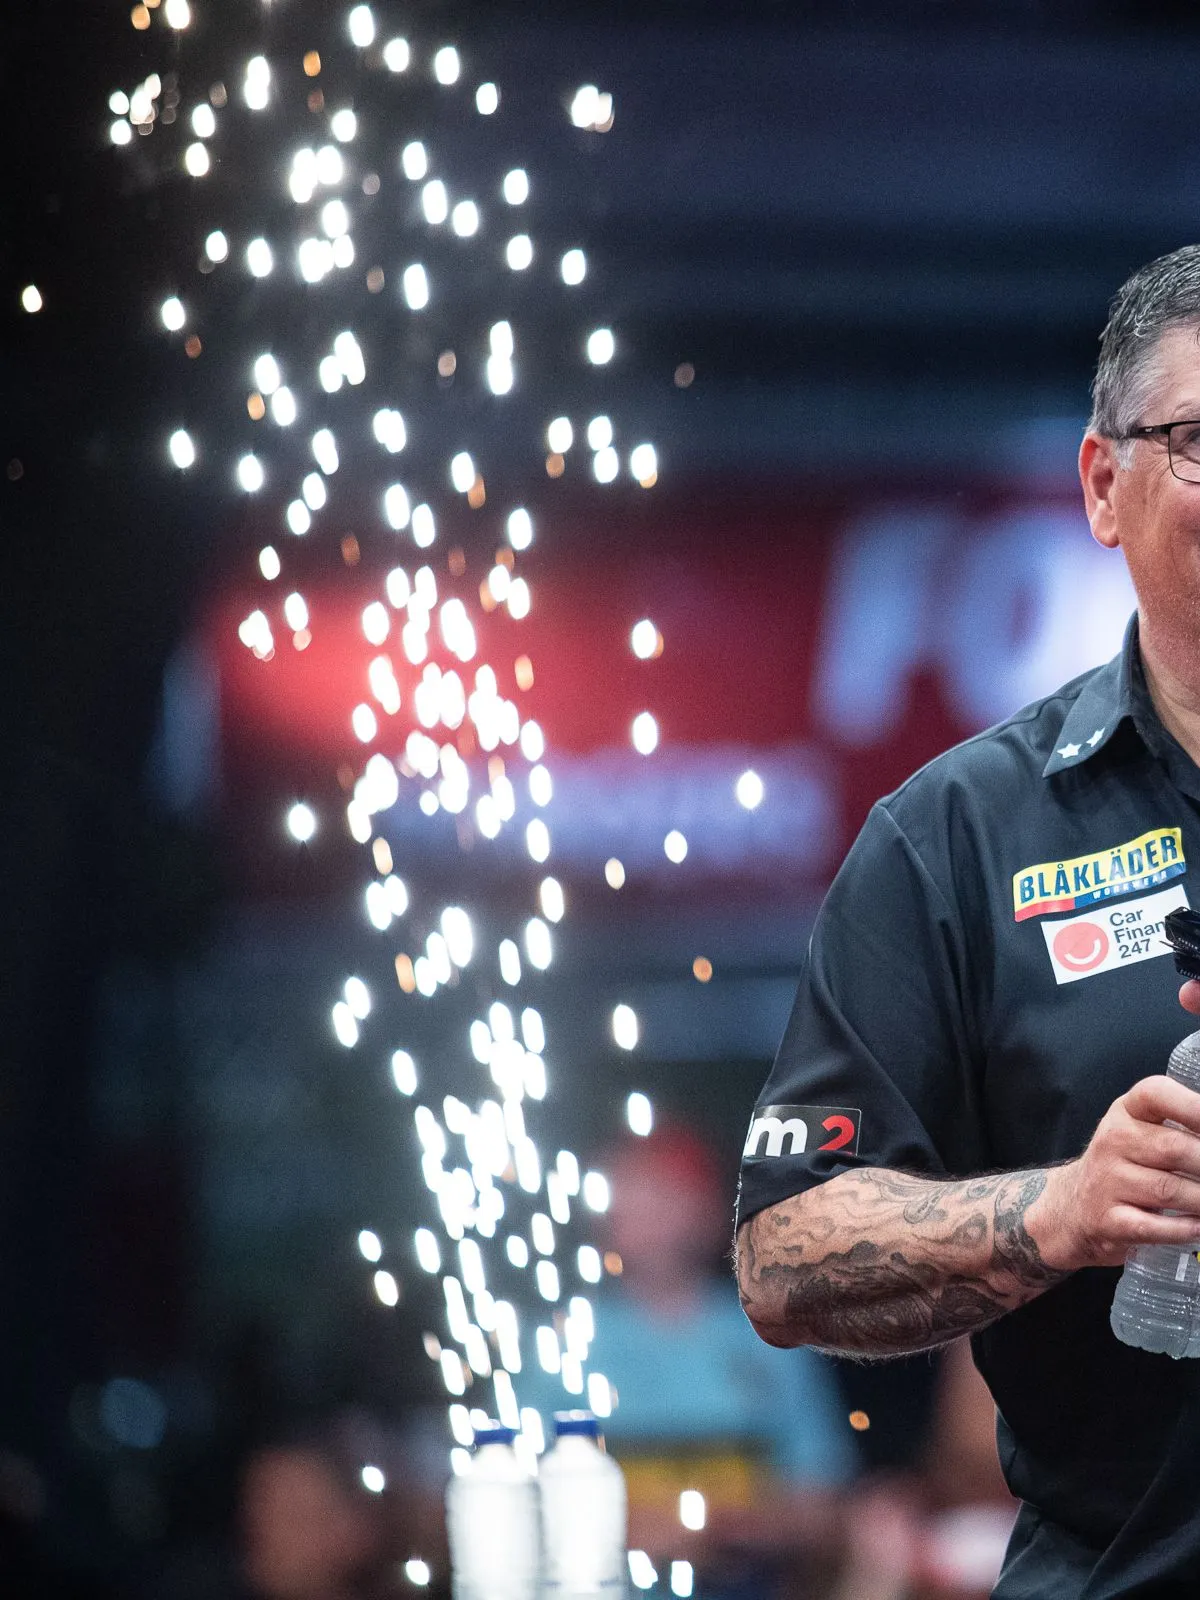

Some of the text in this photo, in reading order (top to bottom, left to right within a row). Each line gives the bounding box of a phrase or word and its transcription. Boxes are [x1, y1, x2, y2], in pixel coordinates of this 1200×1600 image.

[1019, 835, 1178, 904] BLÅKLÄDER
[1092, 870, 1167, 899] WORKWEAR
[1109, 909, 1144, 927] Car
[1113, 919, 1166, 944] Finan
[1118, 938, 1151, 959] 247
